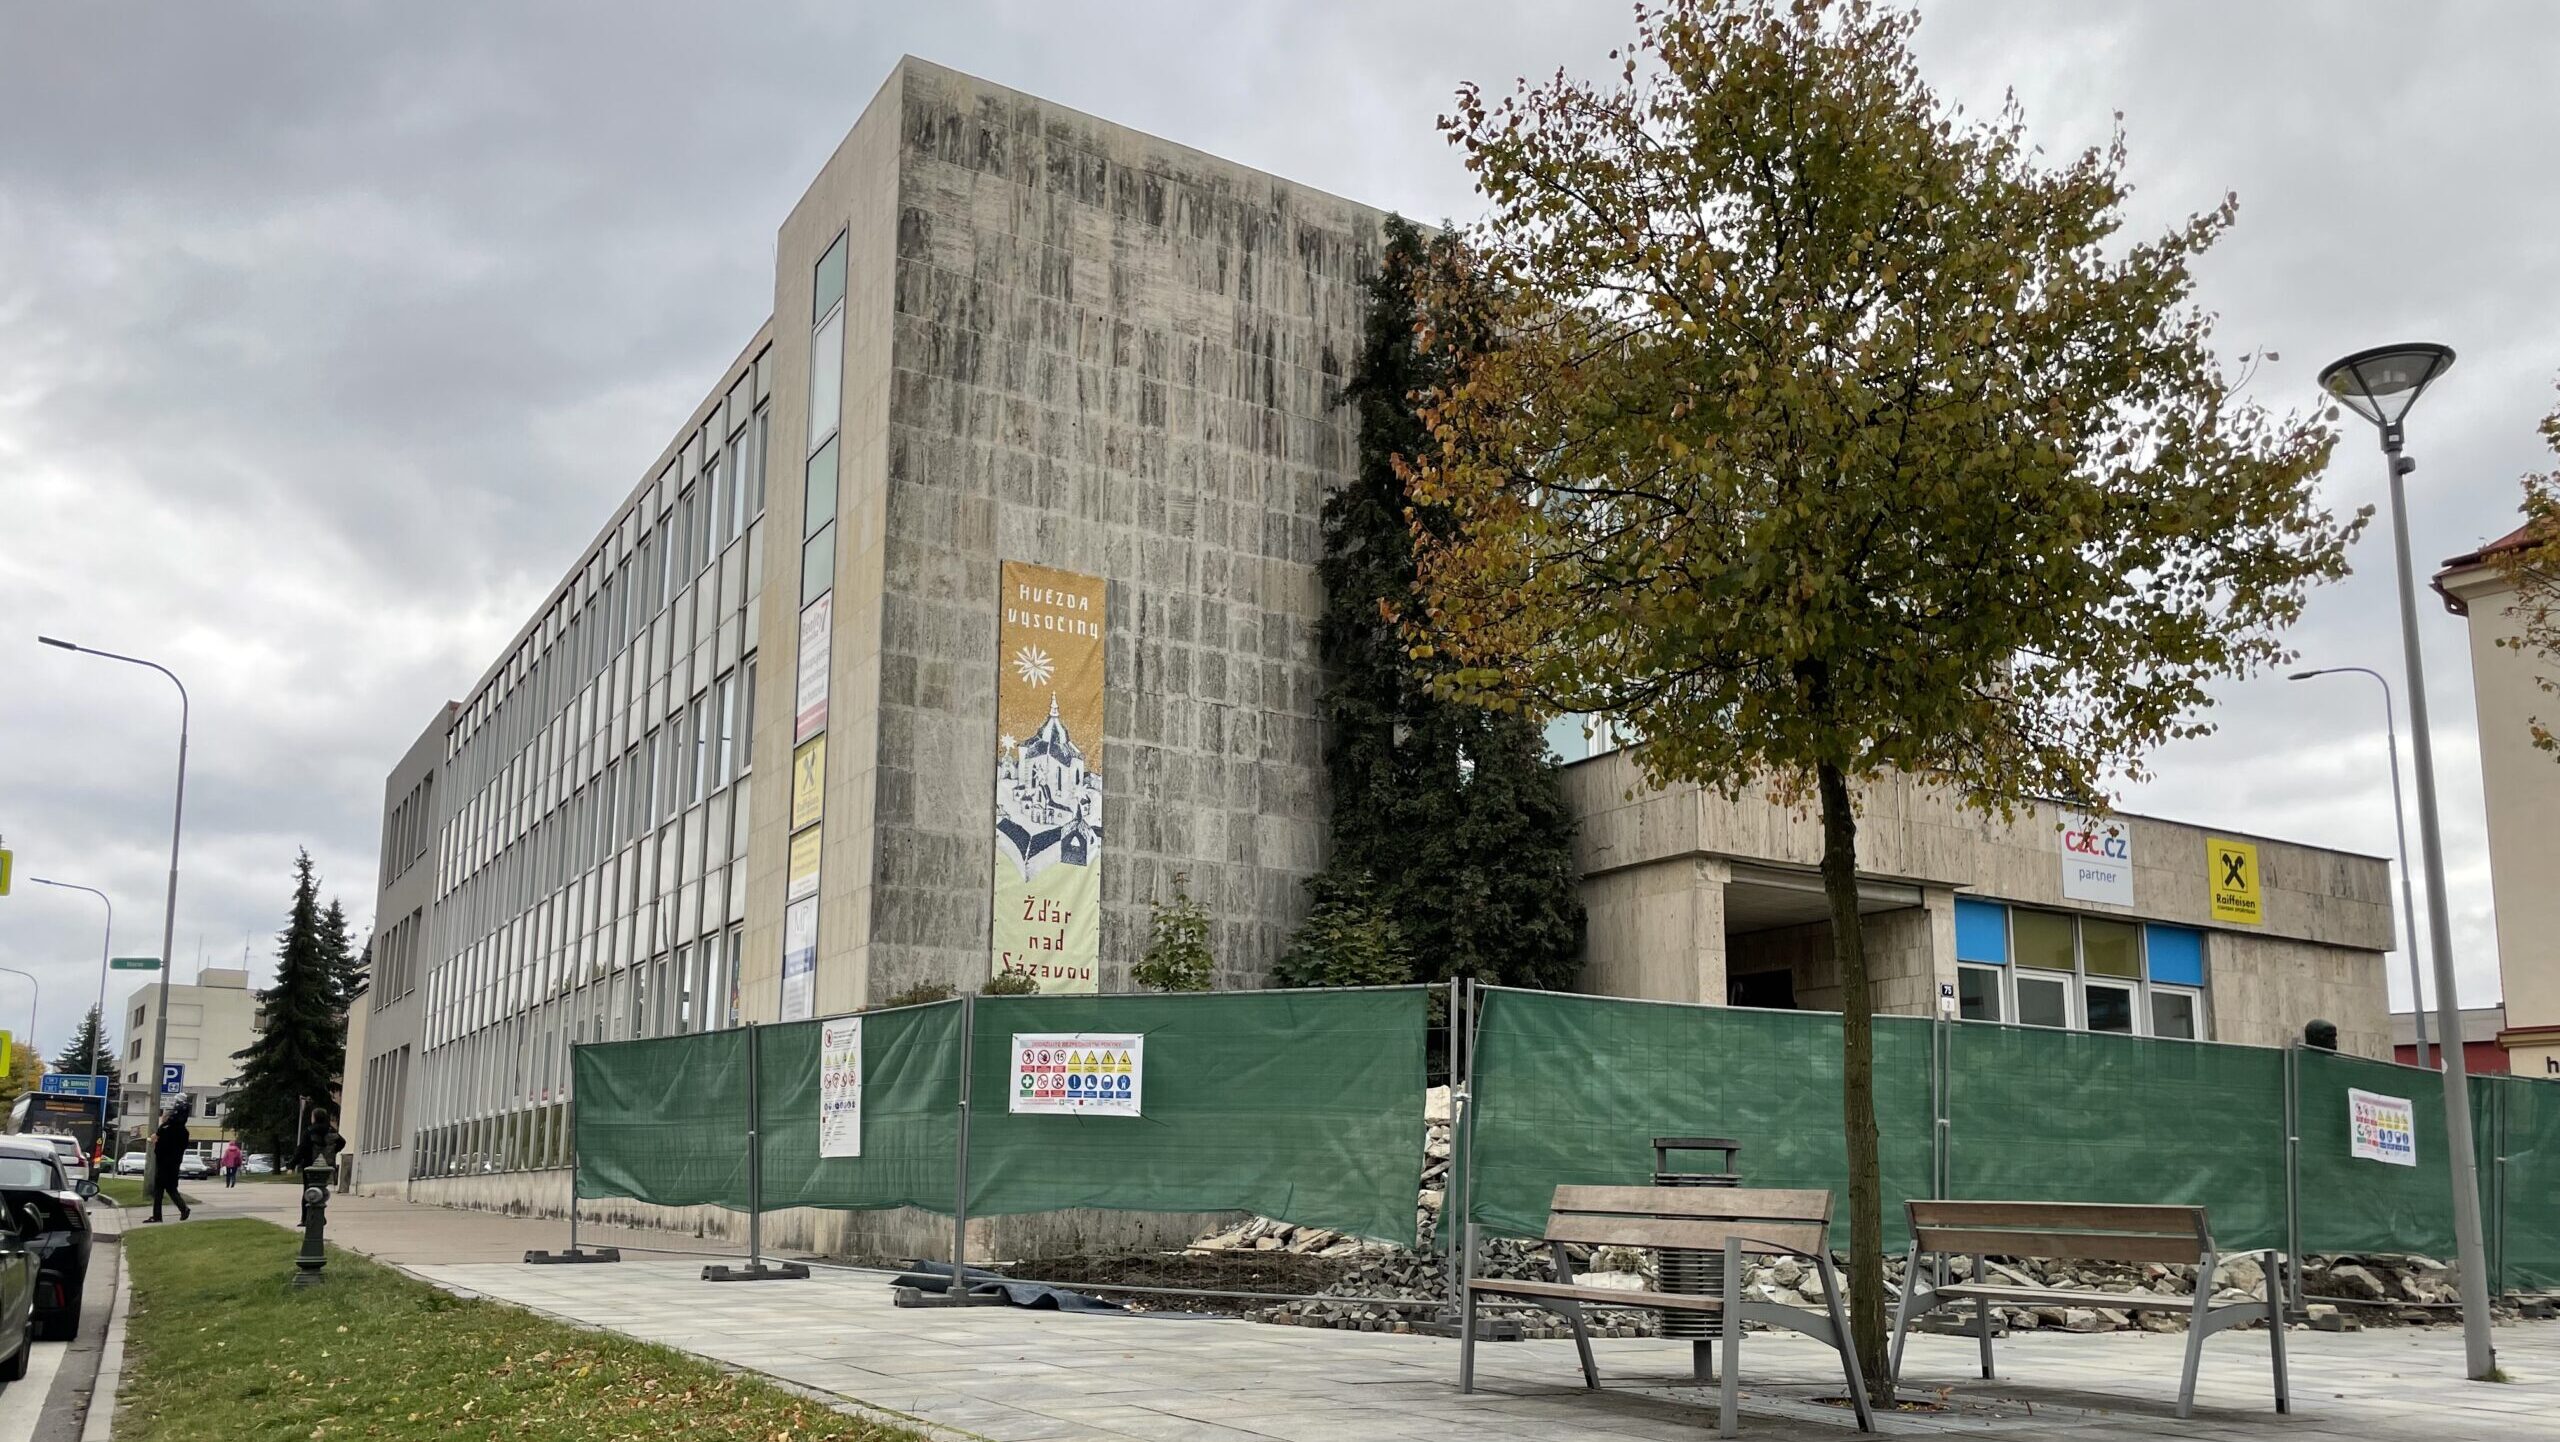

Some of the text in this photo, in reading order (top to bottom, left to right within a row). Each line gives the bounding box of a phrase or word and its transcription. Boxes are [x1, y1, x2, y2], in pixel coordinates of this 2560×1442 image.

[2079, 868, 2117, 884] partner
[1023, 895, 1072, 924] Žďár
[2216, 893, 2256, 909] Raiffeisen
[1029, 929, 1064, 951] nad
[1056, 1053, 1065, 1061] 15
[163, 1067, 178, 1085] P
